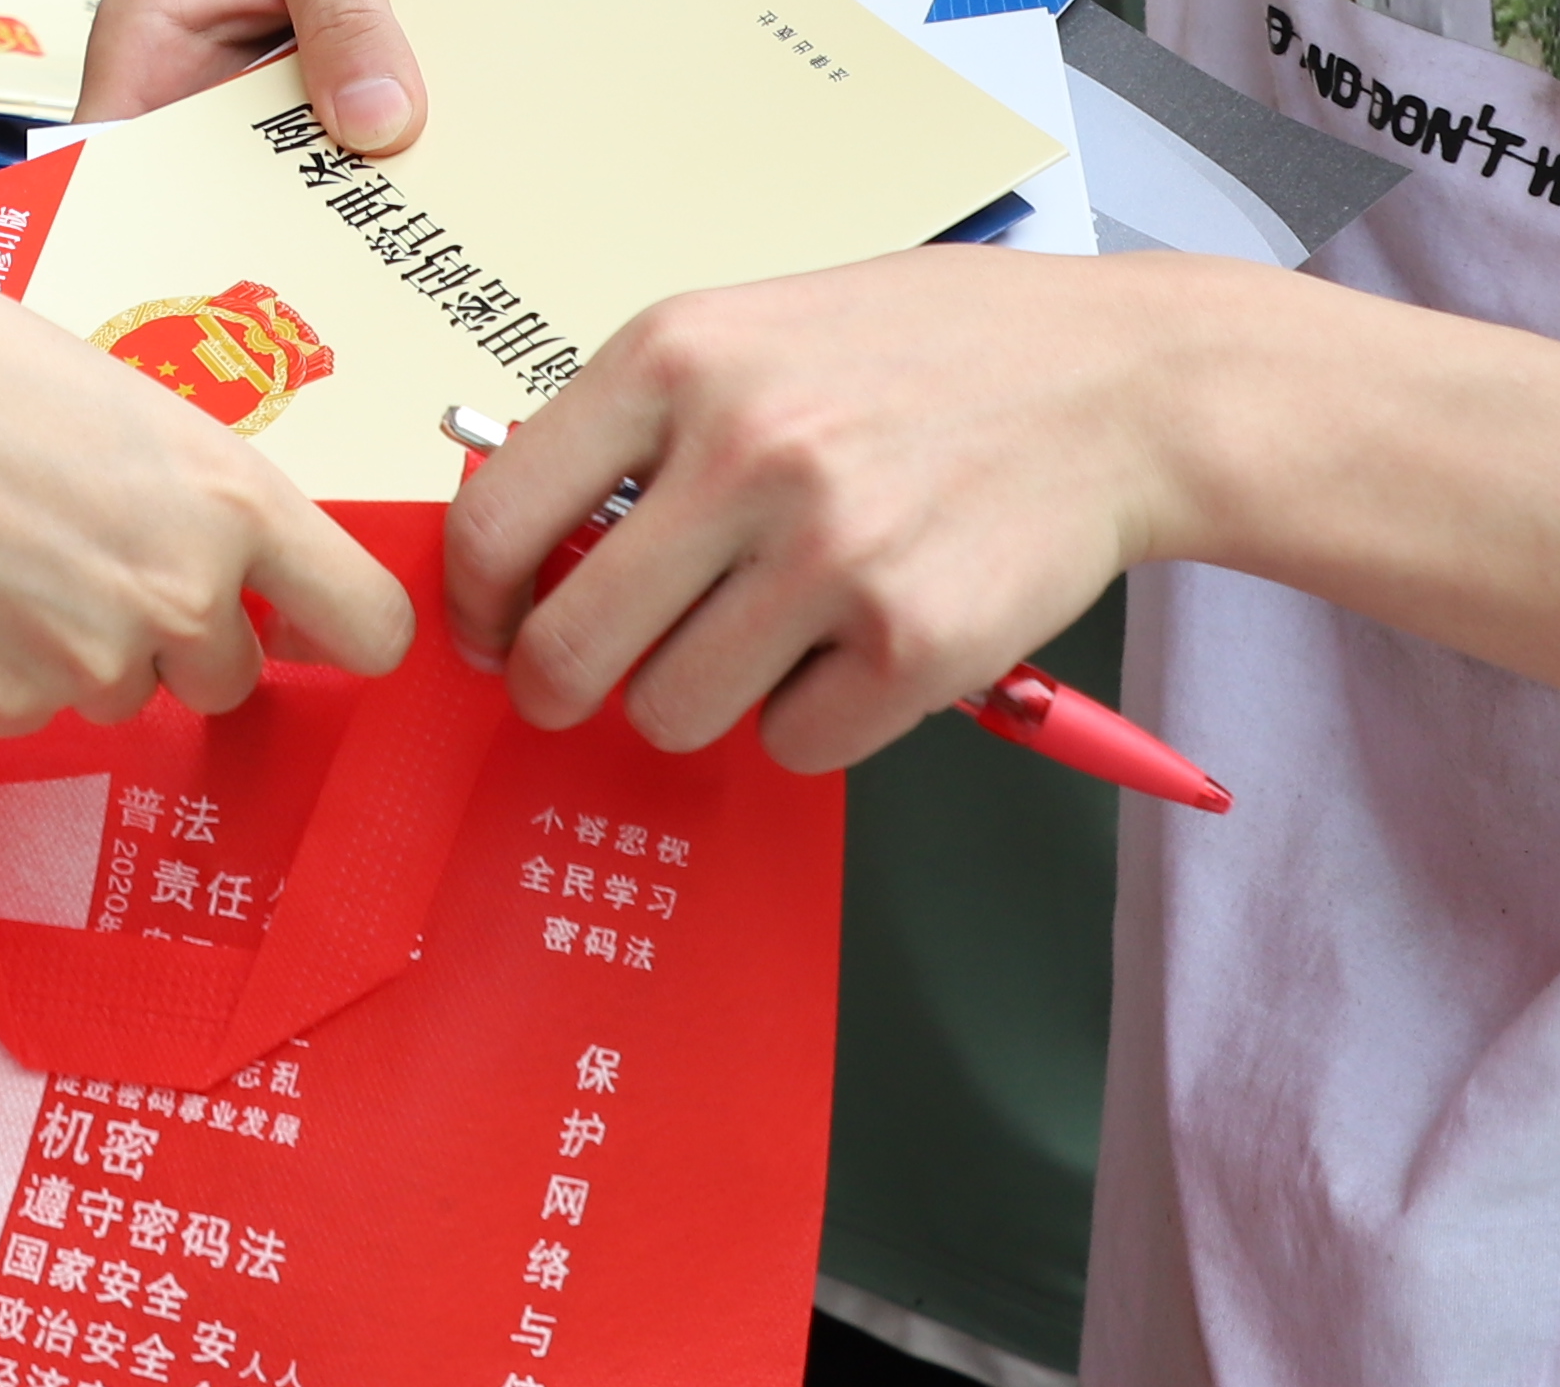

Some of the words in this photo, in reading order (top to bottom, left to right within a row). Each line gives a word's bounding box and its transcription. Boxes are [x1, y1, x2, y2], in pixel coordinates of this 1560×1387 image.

[756, 10, 850, 82] 法律出版社
[1299, 43, 1362, 109] ND
[1368, 78, 1527, 178] DON'T
[251, 103, 586, 401] 商用密码管理条例
[118, 784, 221, 844] 普法
[531, 805, 692, 868] 不容忽视
[150, 858, 254, 921] 责任
[519, 856, 678, 921] 全民学习
[542, 916, 656, 972] 密码法
[38, 1102, 160, 1182] 机密
[18, 1173, 287, 1285] 遵守密码法
[503, 1044, 621, 1387] 保护网络与
[2, 1232, 189, 1322] 国家安全
